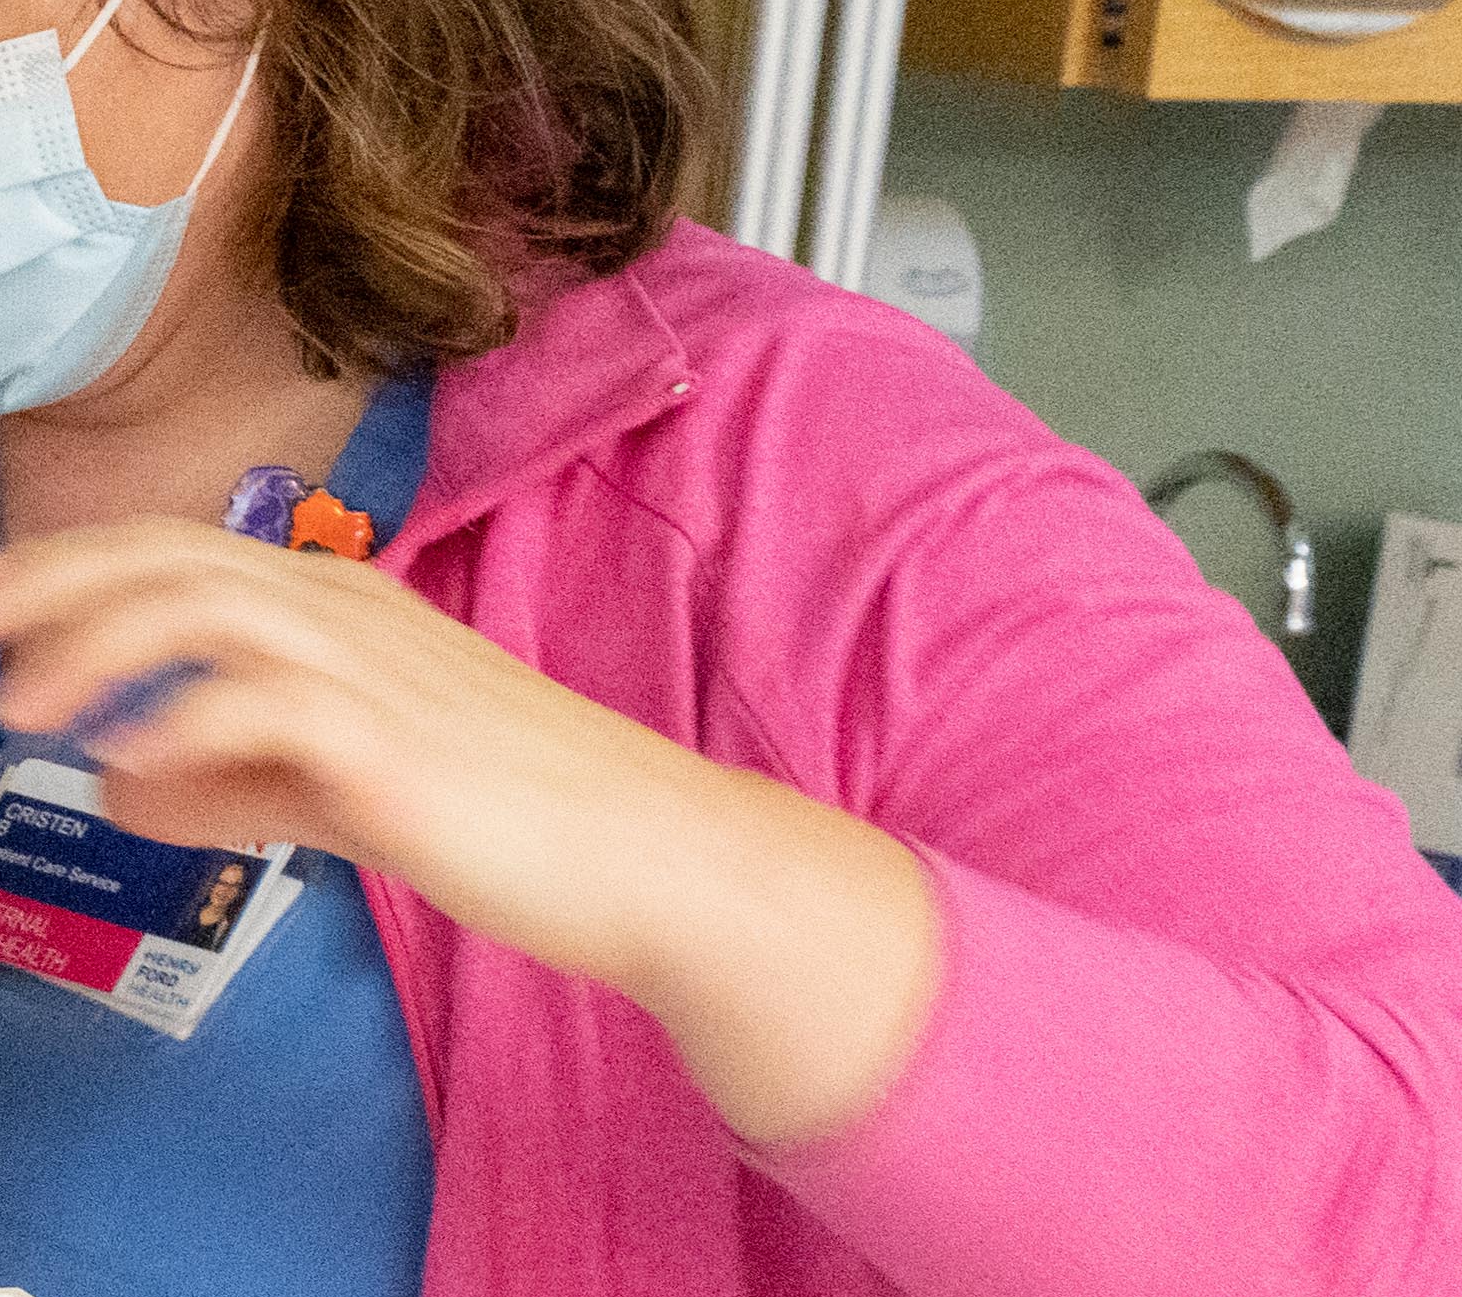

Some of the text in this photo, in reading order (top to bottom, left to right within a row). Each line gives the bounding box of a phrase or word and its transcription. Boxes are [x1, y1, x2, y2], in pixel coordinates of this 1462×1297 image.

[3, 802, 90, 840] CRISTEN
[32, 856, 68, 878] Care
[68, 865, 122, 894] Service
[137, 965, 180, 990] FORD
[143, 949, 202, 977] HENRY
